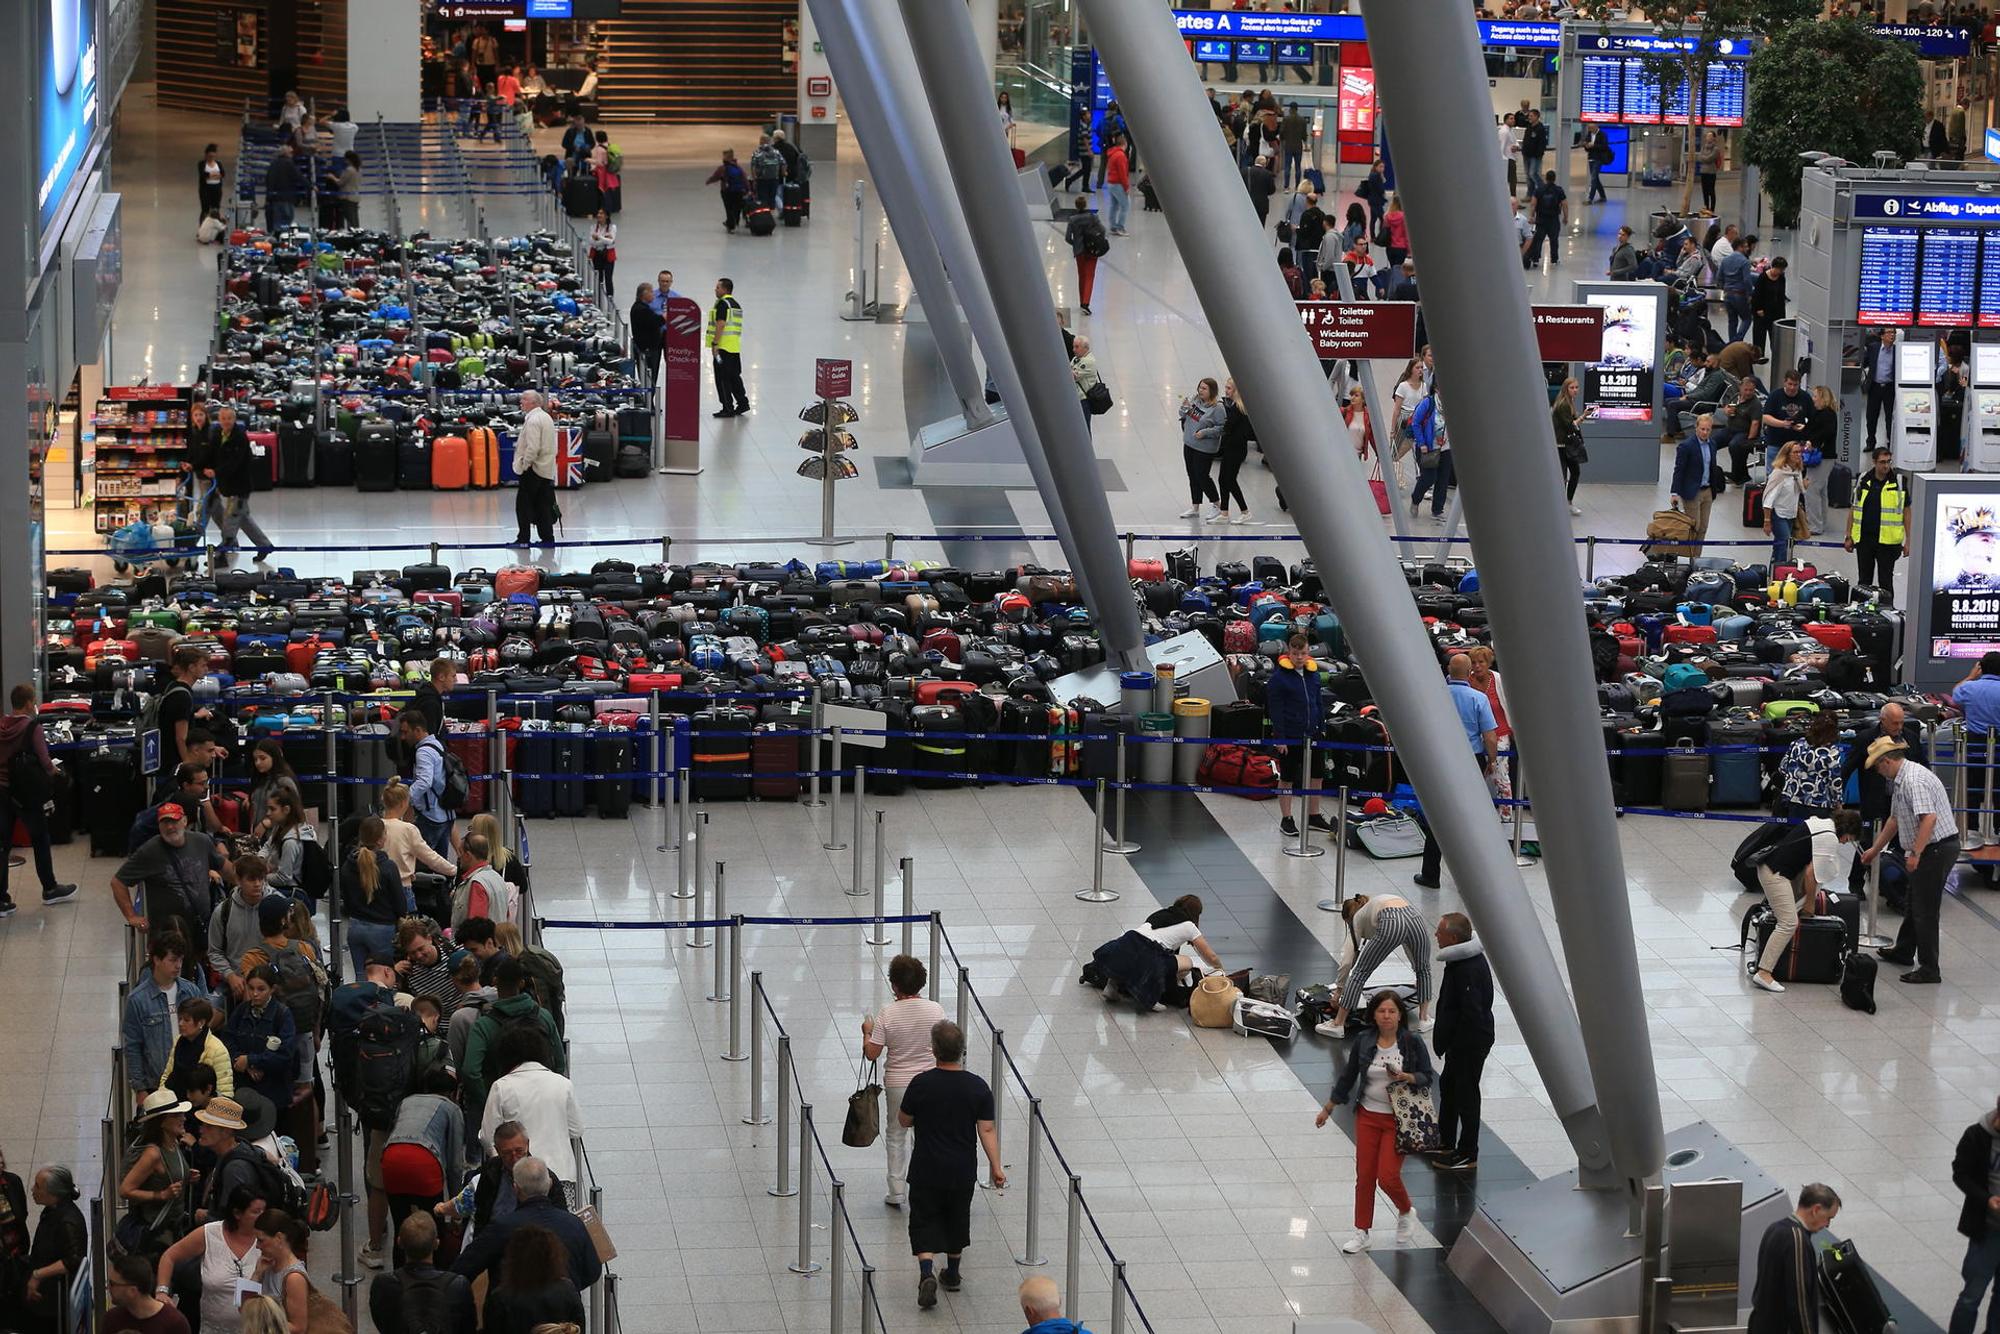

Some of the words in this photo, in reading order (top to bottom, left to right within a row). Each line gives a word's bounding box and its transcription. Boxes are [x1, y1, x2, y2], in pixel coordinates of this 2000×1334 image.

[1217, 15, 1231, 30] A
[1241, 16, 1264, 26] Zugang
[1491, 25, 1514, 34] Zugang
[1624, 39, 1649, 49] Abflug
[1924, 202, 1959, 215] Abflug
[1546, 316, 1594, 324] Restaurants
[1320, 340, 1339, 349] Baby
[1841, 411, 1853, 462] Eurowings
[1952, 600, 1999, 612] 9.8.2019
